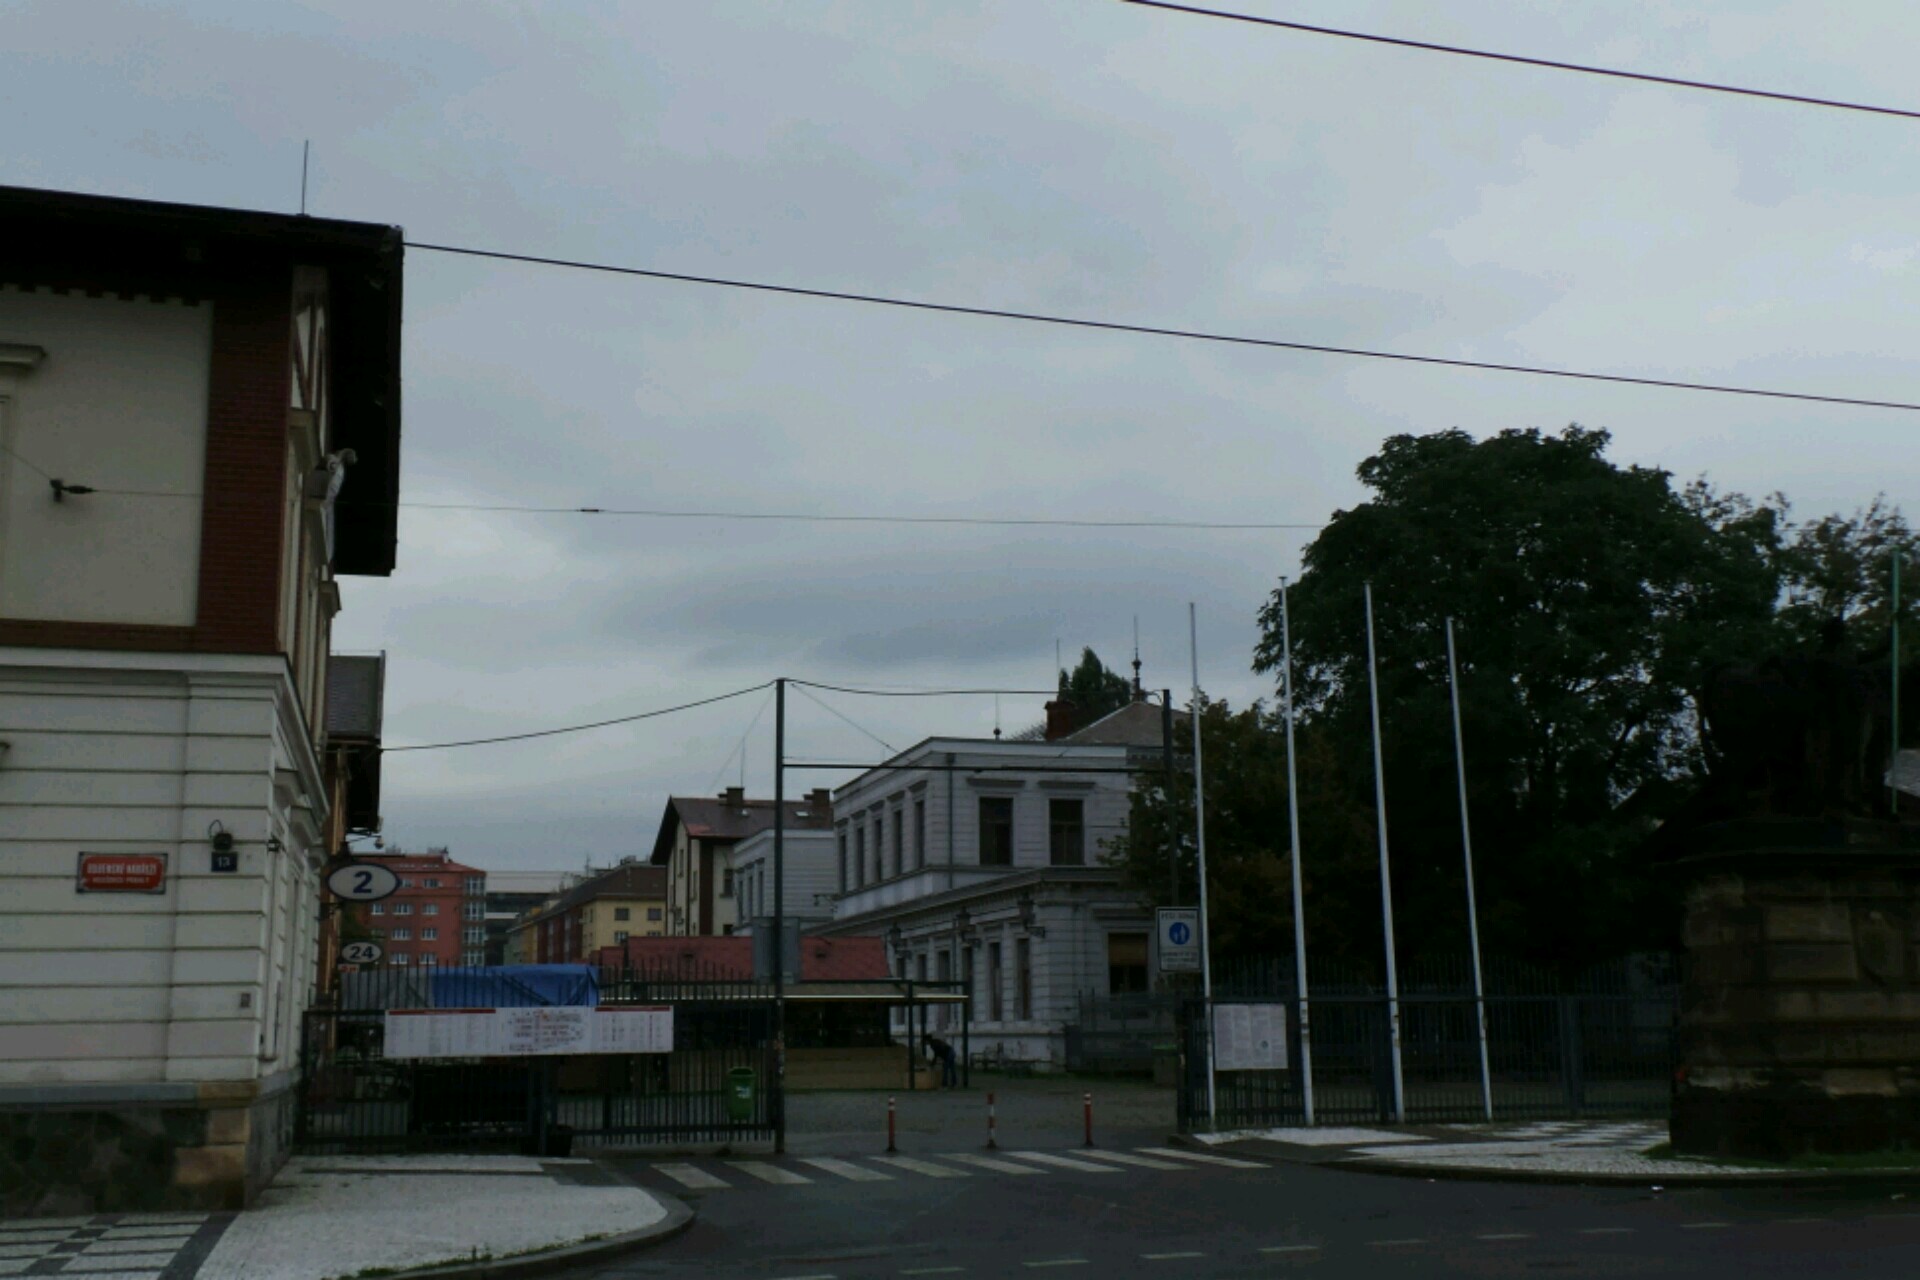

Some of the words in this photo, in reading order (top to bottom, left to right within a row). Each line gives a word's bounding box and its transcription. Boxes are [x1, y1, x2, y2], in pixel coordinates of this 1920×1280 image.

[217, 856, 230, 868] 13
[353, 871, 372, 893] 2
[350, 946, 374, 959] 24
